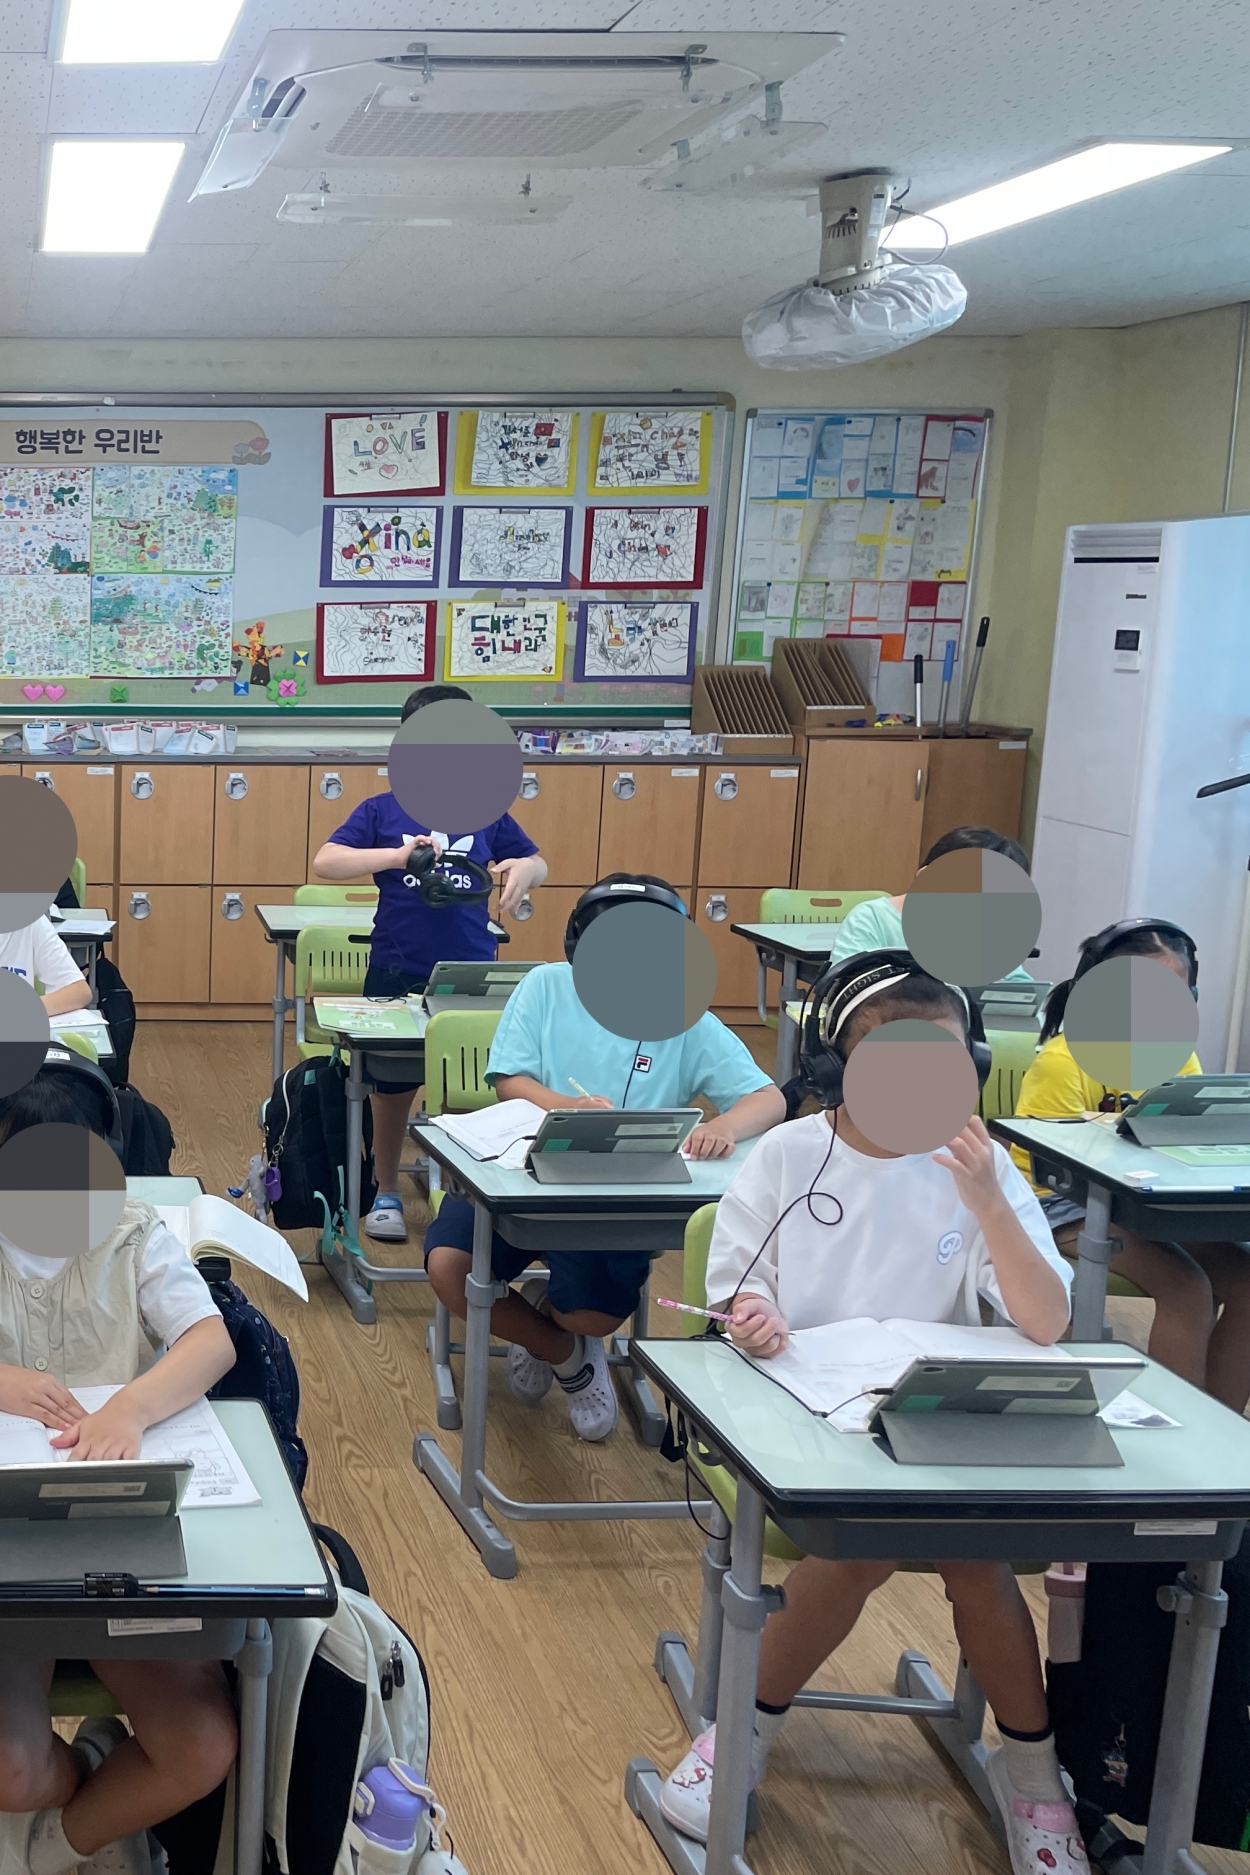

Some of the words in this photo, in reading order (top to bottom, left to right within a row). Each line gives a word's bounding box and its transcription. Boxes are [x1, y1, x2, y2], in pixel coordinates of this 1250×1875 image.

[15, 428, 86, 455] 행복한
[93, 428, 163, 455] 우리반
[471, 613, 547, 642] 대한민국
[471, 635, 541, 663] 힘내라
[403, 869, 472, 889] aas
